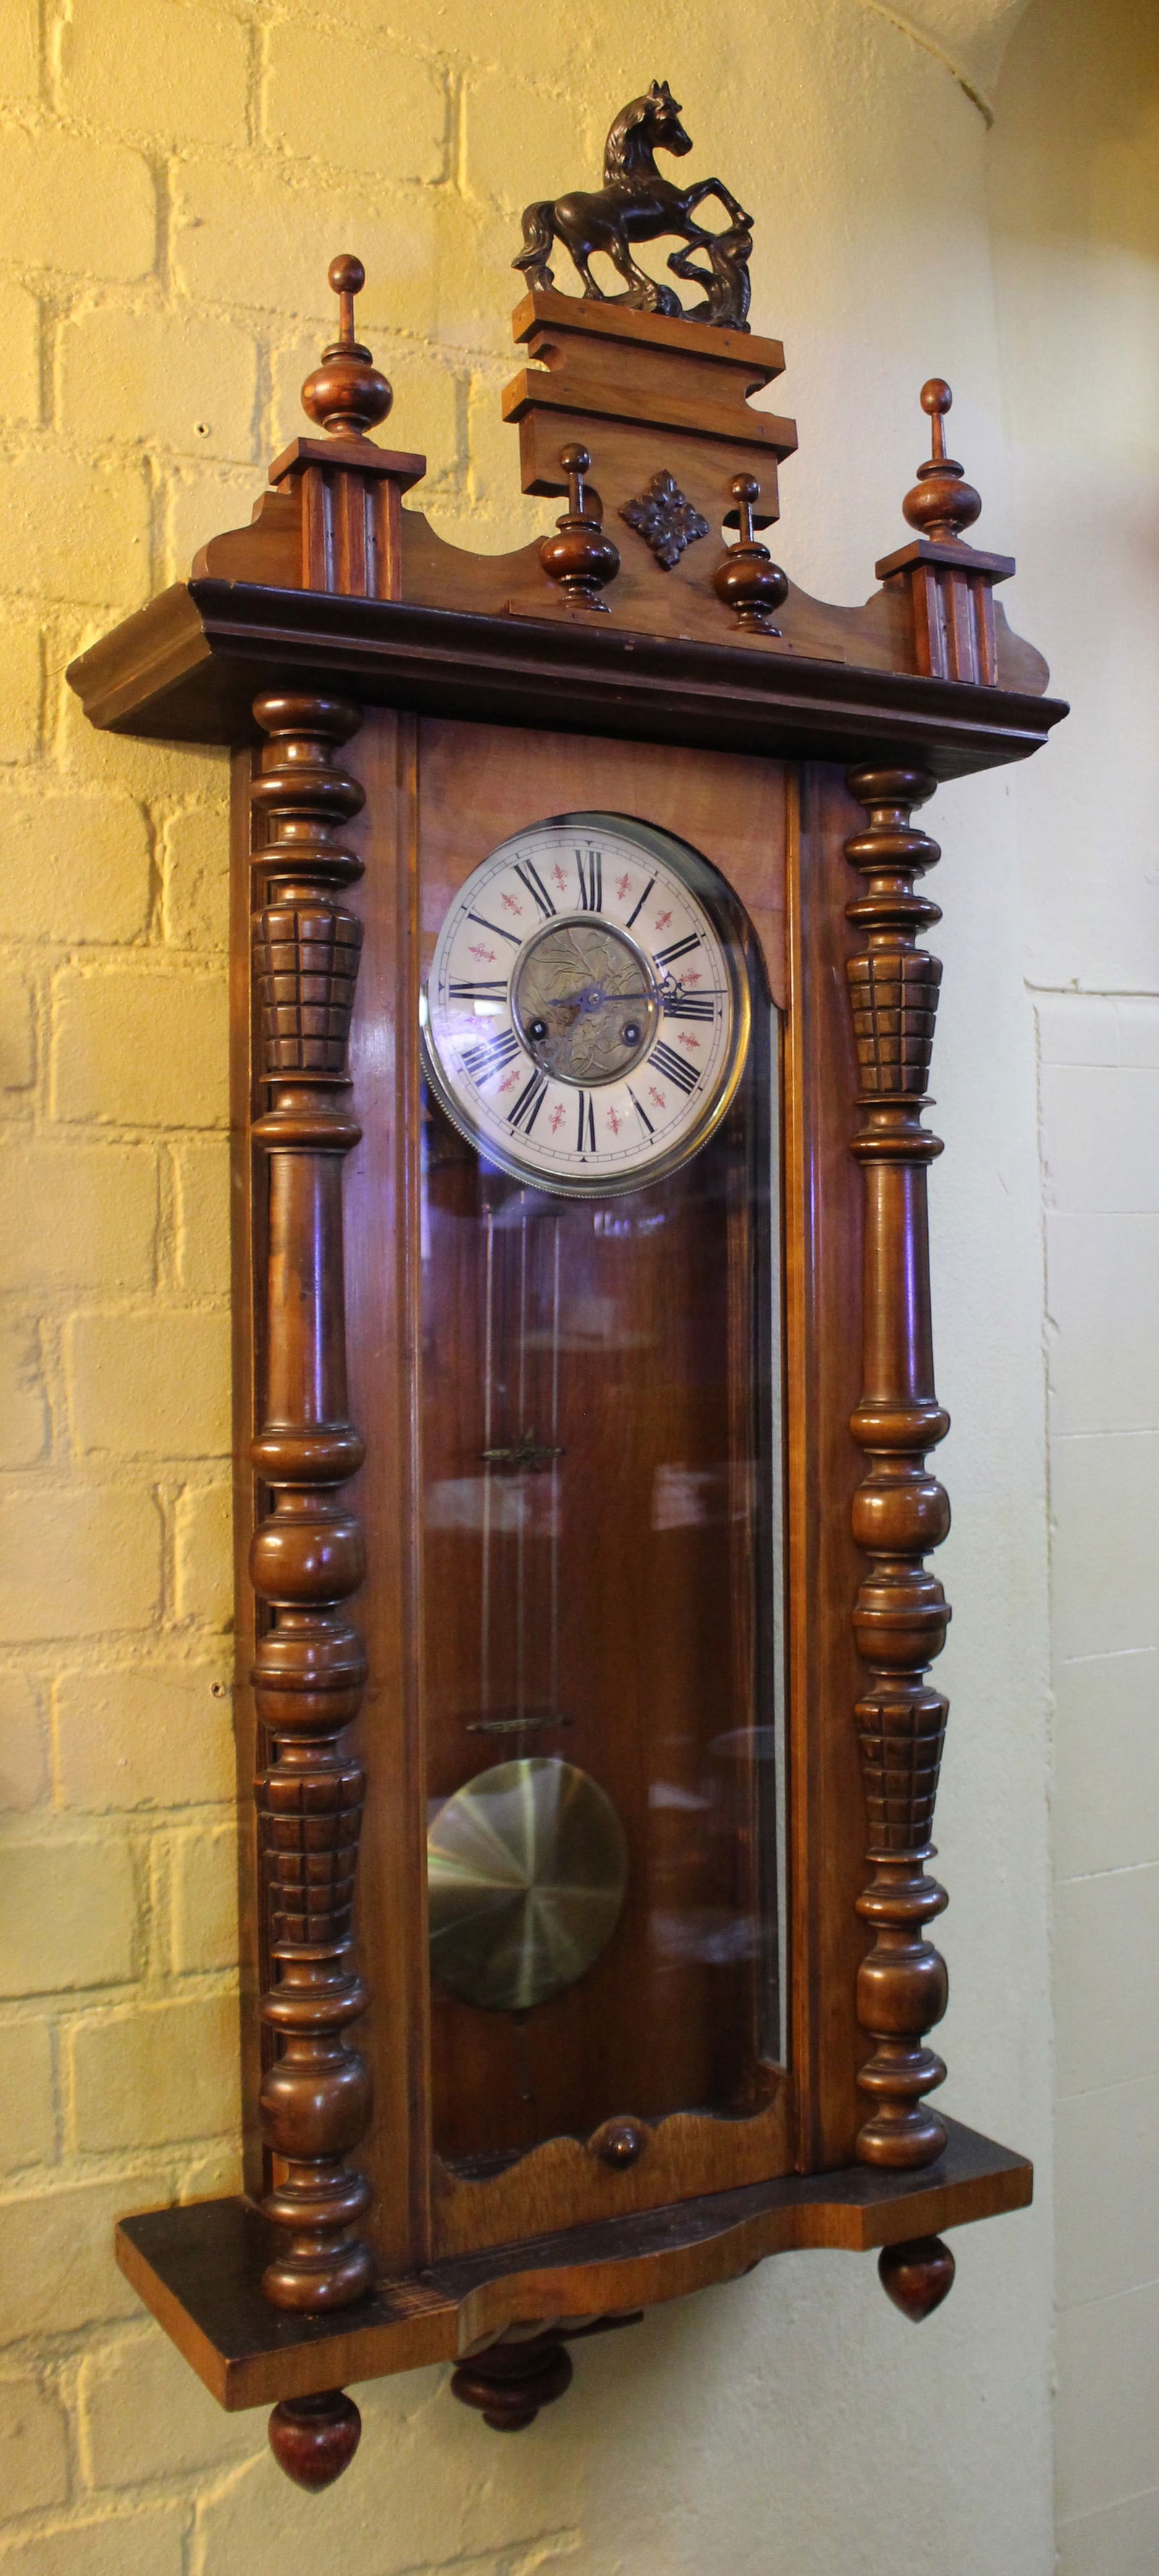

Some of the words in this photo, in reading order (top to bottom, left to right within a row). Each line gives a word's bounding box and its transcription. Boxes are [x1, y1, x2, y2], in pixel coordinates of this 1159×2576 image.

[510, 857, 558, 923] XI
[574, 849, 603, 913] XII
[624, 876, 657, 930] I
[466, 905, 524, 954] X
[651, 932, 702, 969] II
[448, 974, 508, 1002] IX
[662, 996, 714, 1023] III
[461, 1028, 523, 1088] VIII
[647, 1038, 701, 1096] IIII
[505, 1068, 550, 1136] VII
[575, 1089, 599, 1153] VI
[625, 1083, 657, 1139] V
